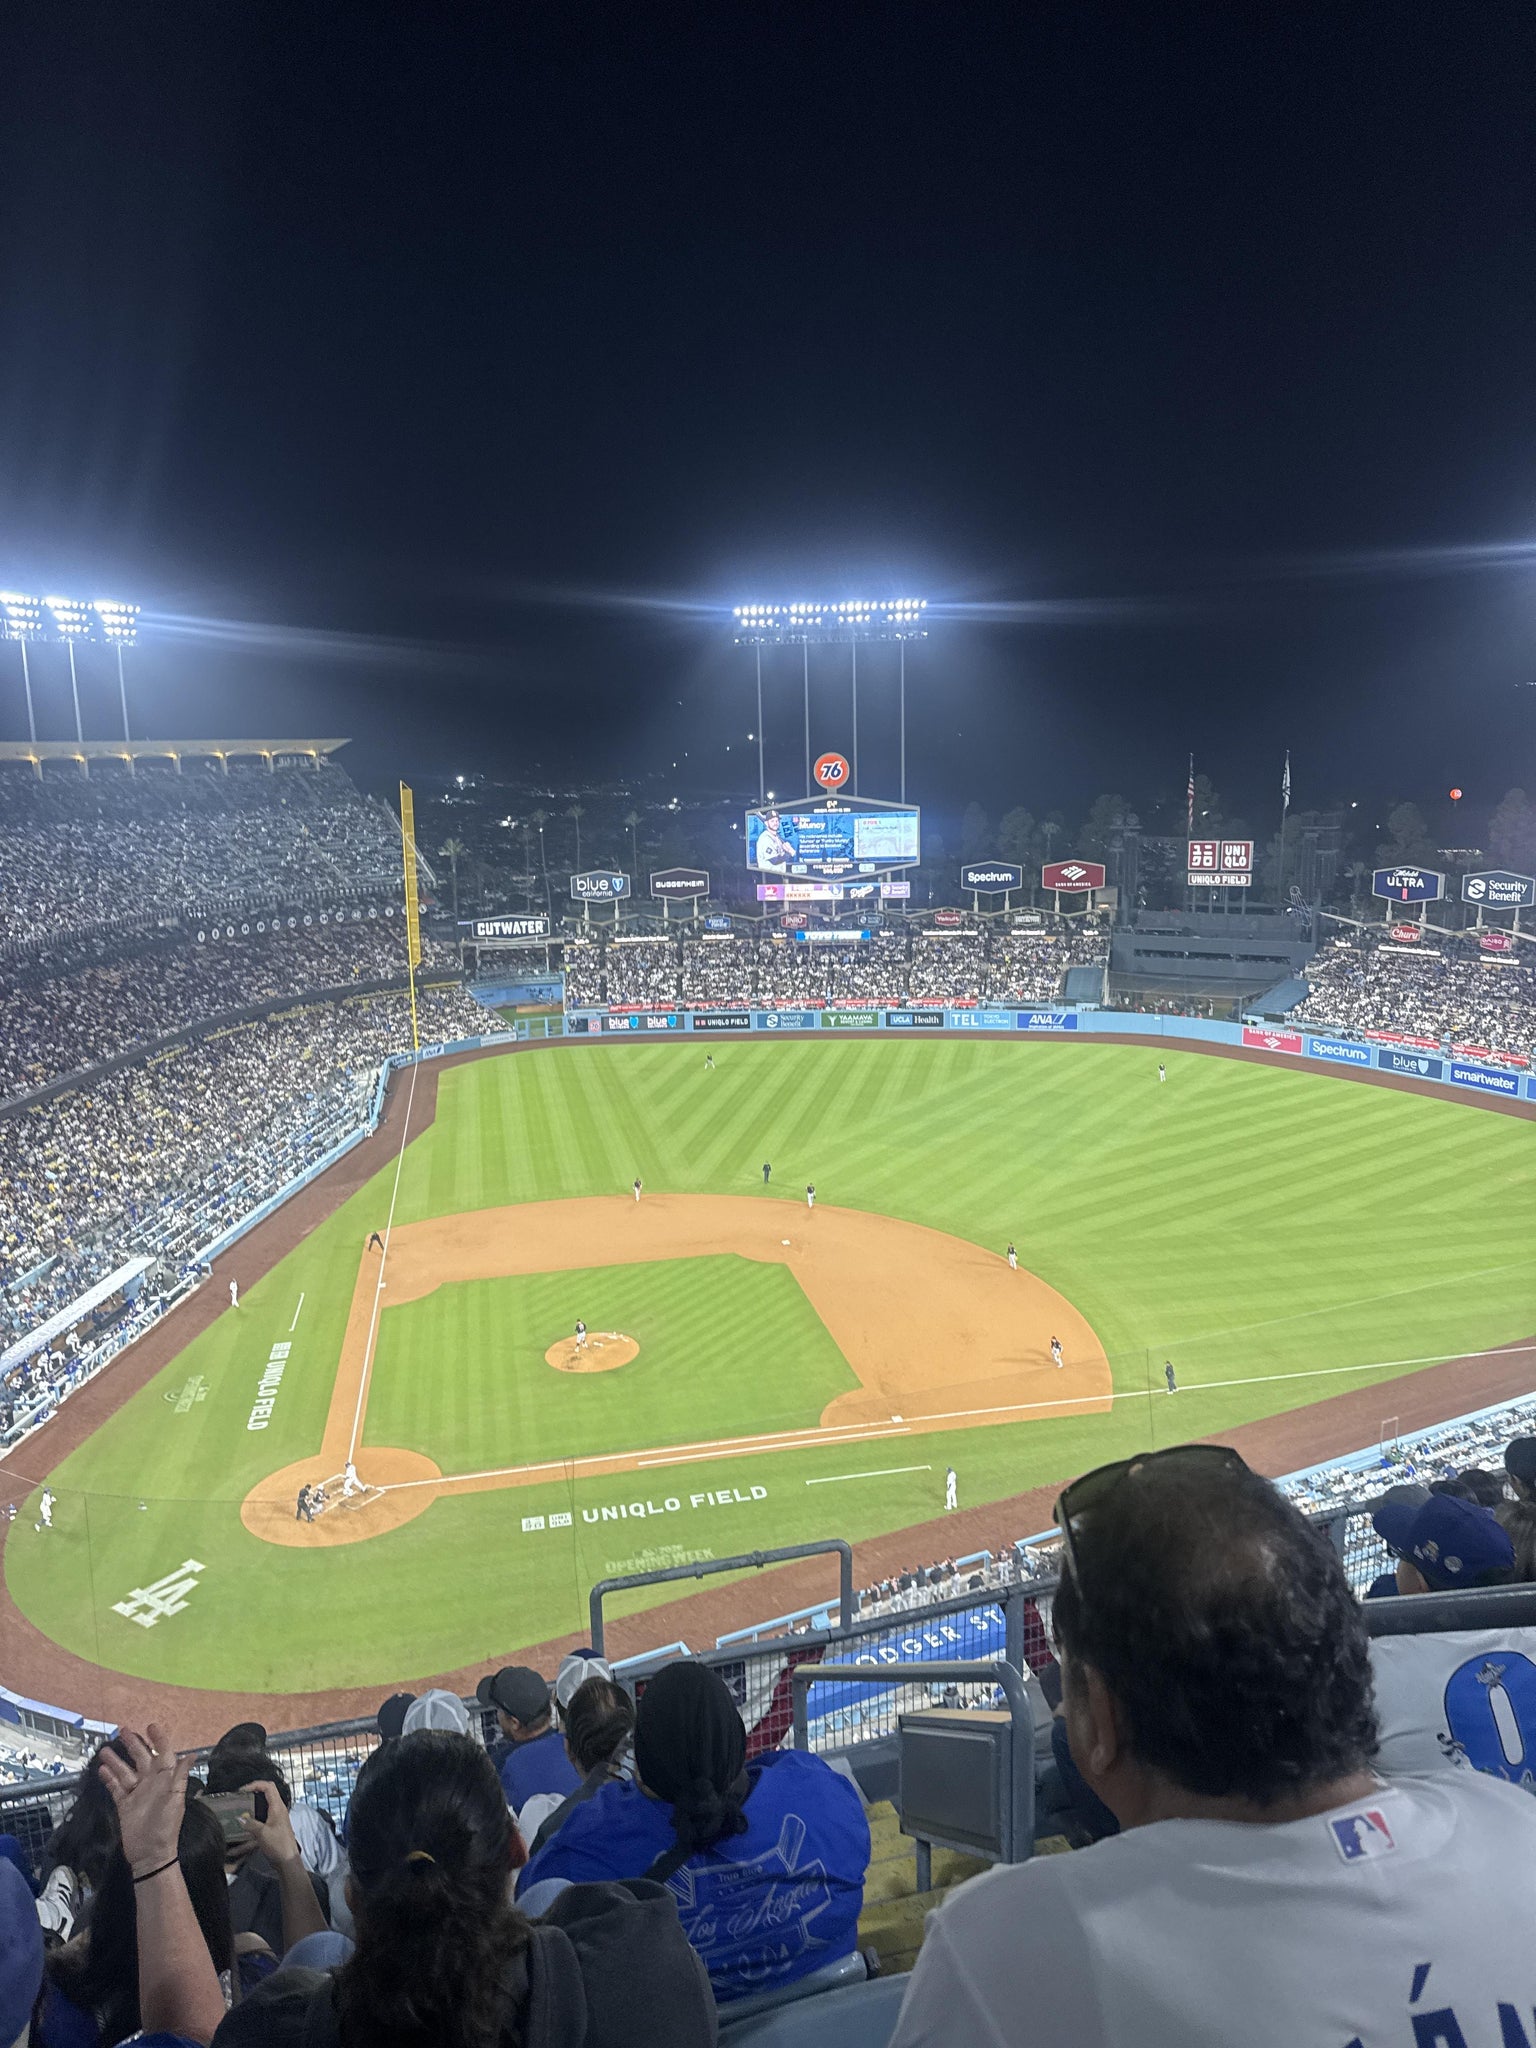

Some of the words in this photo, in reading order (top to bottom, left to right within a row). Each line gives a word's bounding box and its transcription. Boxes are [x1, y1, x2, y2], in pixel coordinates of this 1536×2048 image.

[821, 761, 843, 780] 76
[1225, 845, 1246, 856] UNI
[1224, 856, 1247, 868] QLO
[577, 877, 609, 891] blue
[655, 880, 705, 888] GUGGENHEIM
[968, 872, 1013, 884] Spectrum
[1191, 875, 1221, 885] UNIQLO
[1222, 875, 1247, 885] FIELD
[1386, 877, 1425, 888] ULTRA
[1489, 879, 1528, 894] Security
[582, 889, 613, 897] california
[1488, 891, 1522, 902] Benefit
[477, 920, 545, 935] CUTWATER
[1392, 928, 1419, 940] Churu
[608, 1016, 629, 1026] blue
[647, 1016, 667, 1025] blue
[780, 1013, 804, 1022] Security
[893, 1016, 910, 1024] UCLA
[914, 1015, 939, 1024] Health
[952, 1014, 979, 1026] TEL
[1029, 1014, 1053, 1024] ANA
[1272, 1032, 1296, 1041] AMERICA
[1313, 1040, 1362, 1060] Spectrum
[1393, 1055, 1417, 1069] blue
[1454, 1068, 1515, 1090] smartwater
[257, 1360, 287, 1397] UNIQLO
[247, 1397, 276, 1431] FIELD
[582, 1497, 681, 1523] UNIQLO
[690, 1485, 768, 1508] FIELD
[855, 1625, 962, 1666] ODGER
